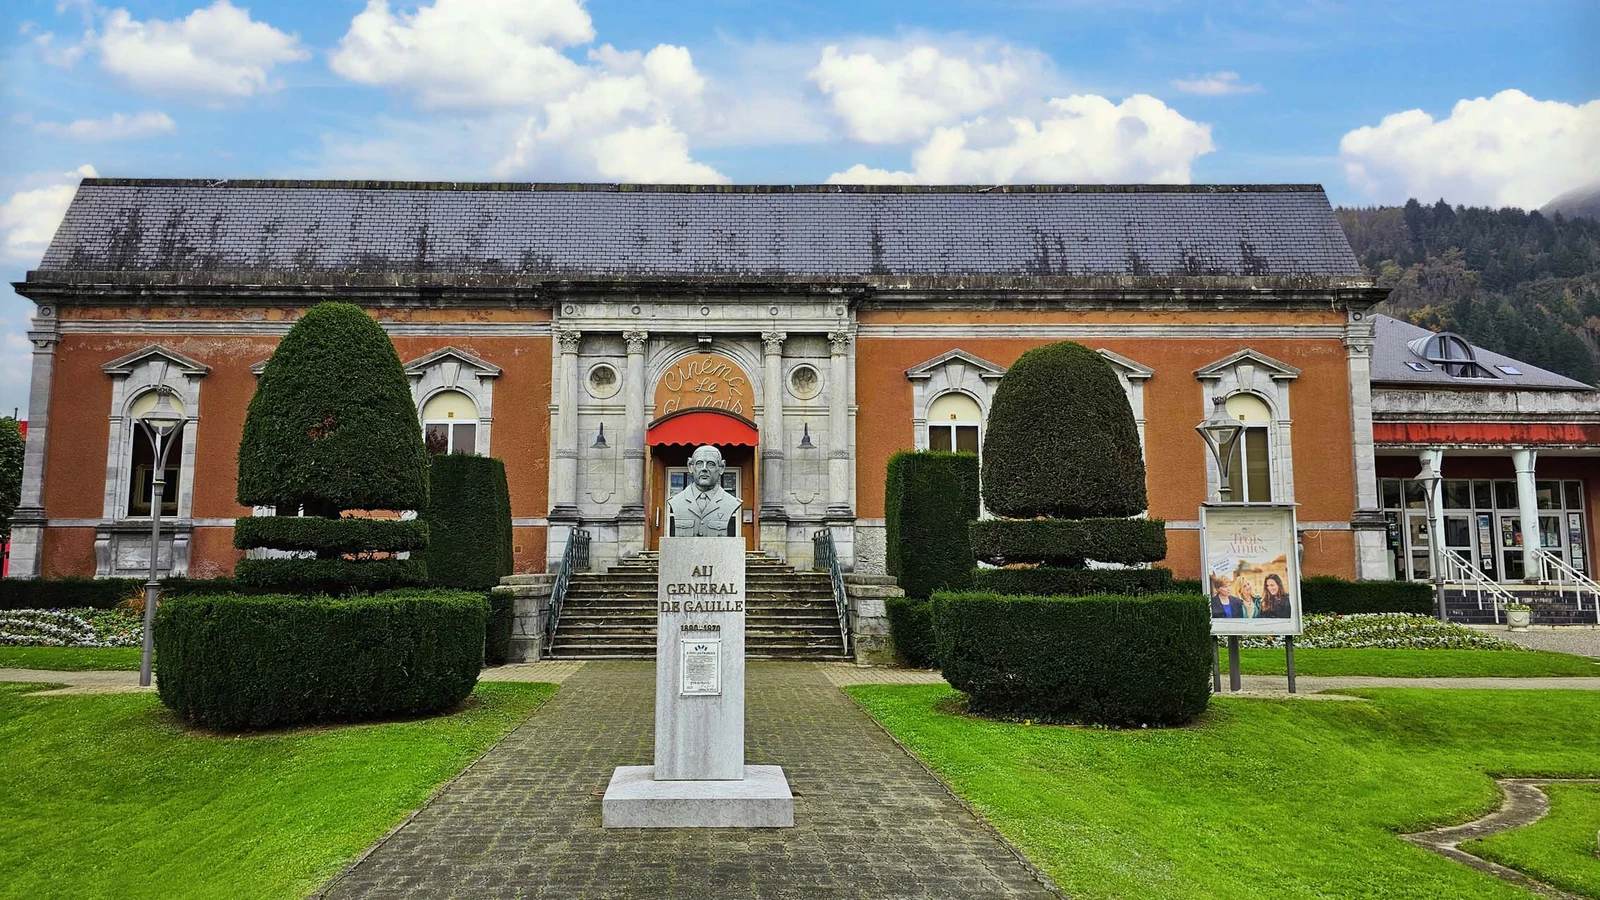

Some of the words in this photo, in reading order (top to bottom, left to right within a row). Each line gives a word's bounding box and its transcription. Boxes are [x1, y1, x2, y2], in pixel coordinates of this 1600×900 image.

[694, 376, 718, 393] Le
[1230, 532, 1263, 545] Trois
[1226, 541, 1269, 554] Amies
[691, 565, 713, 577] AU
[666, 583, 738, 595] GENERAL
[660, 601, 680, 613] DE
[683, 600, 743, 613] GAULLE
